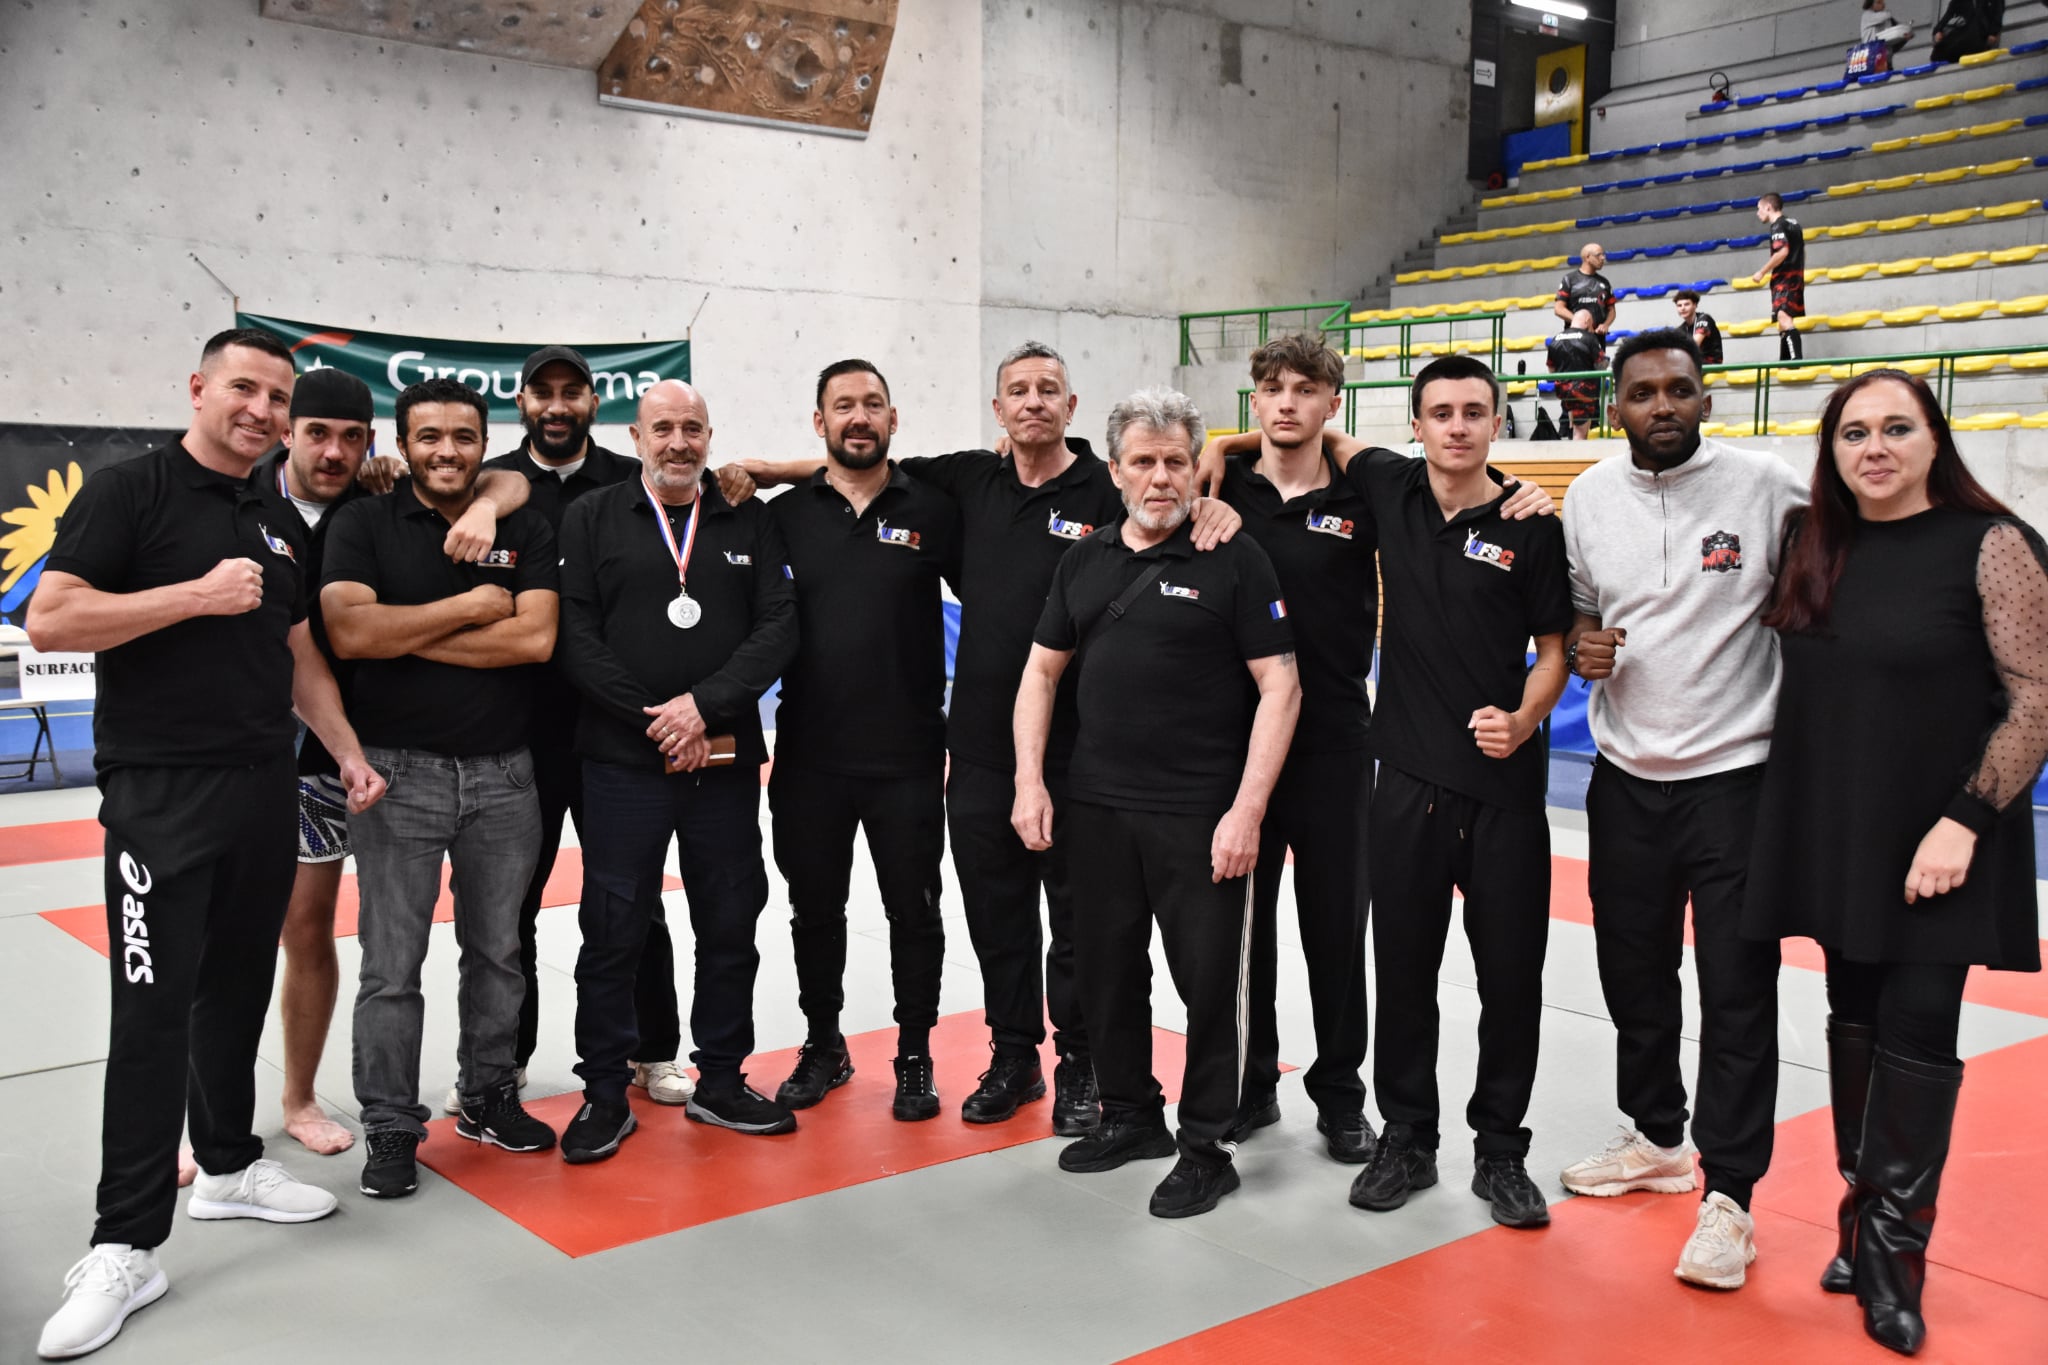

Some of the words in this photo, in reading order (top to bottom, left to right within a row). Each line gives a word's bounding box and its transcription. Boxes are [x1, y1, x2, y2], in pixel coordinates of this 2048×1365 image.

[387, 350, 661, 401] Grouma
[1053, 518, 1094, 537] UFSC
[1311, 514, 1354, 535] UFSC
[881, 527, 921, 545] UFSC
[483, 549, 518, 564] FSC
[1469, 538, 1515, 566] UFSC
[1164, 585, 1200, 598] UFSC
[122, 893, 154, 984] asics
